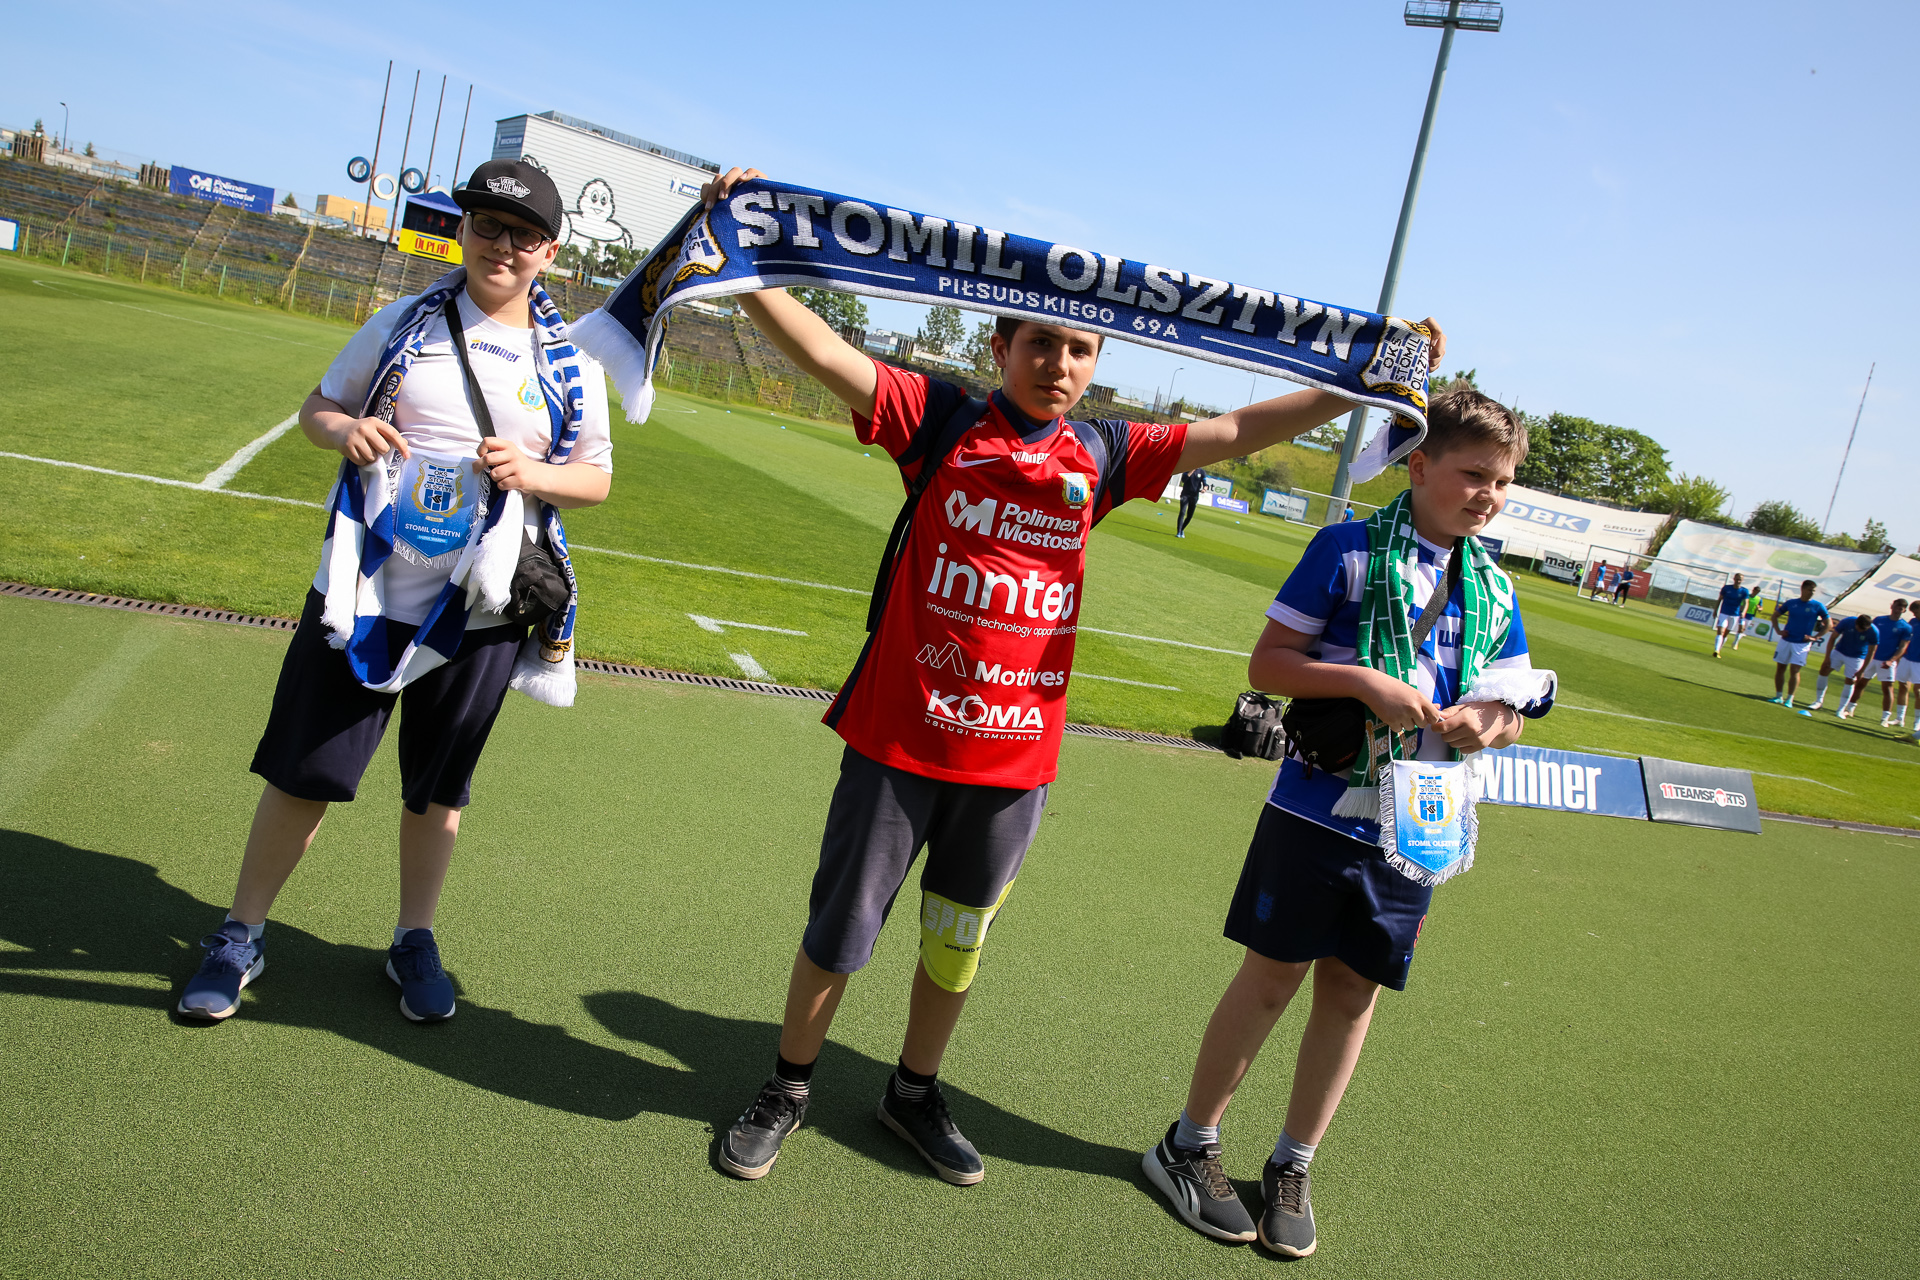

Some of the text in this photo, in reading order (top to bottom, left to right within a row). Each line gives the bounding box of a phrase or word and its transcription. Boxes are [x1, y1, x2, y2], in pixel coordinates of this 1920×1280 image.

[501, 136, 522, 146] MICHELIN
[681, 186, 701, 197] MIC
[415, 237, 450, 256] OLPLAN
[730, 190, 1369, 362] STOMIL OLSZTYN
[938, 276, 1179, 340] PIŁSUDSKIEGO 69A
[1383, 337, 1402, 368] OKS
[1395, 338, 1421, 383] STOMIL
[1410, 342, 1430, 391] OLSZTY
[424, 483, 455, 493] OLSZTYN
[428, 476, 451, 485] STOMIL
[404, 523, 461, 538] STOMIL OLSZTYN
[1000, 502, 1080, 533] Polimex
[1502, 501, 1646, 533] DBK GROUP
[926, 601, 974, 624] innovation
[976, 616, 1033, 638] technology
[1687, 608, 1710, 621] DBK
[974, 660, 1065, 687] Motives
[926, 689, 1045, 730] KOMA
[924, 717, 1042, 741] USŁUGI KOMUNALNE
[945, 943, 961, 952] MOVE
